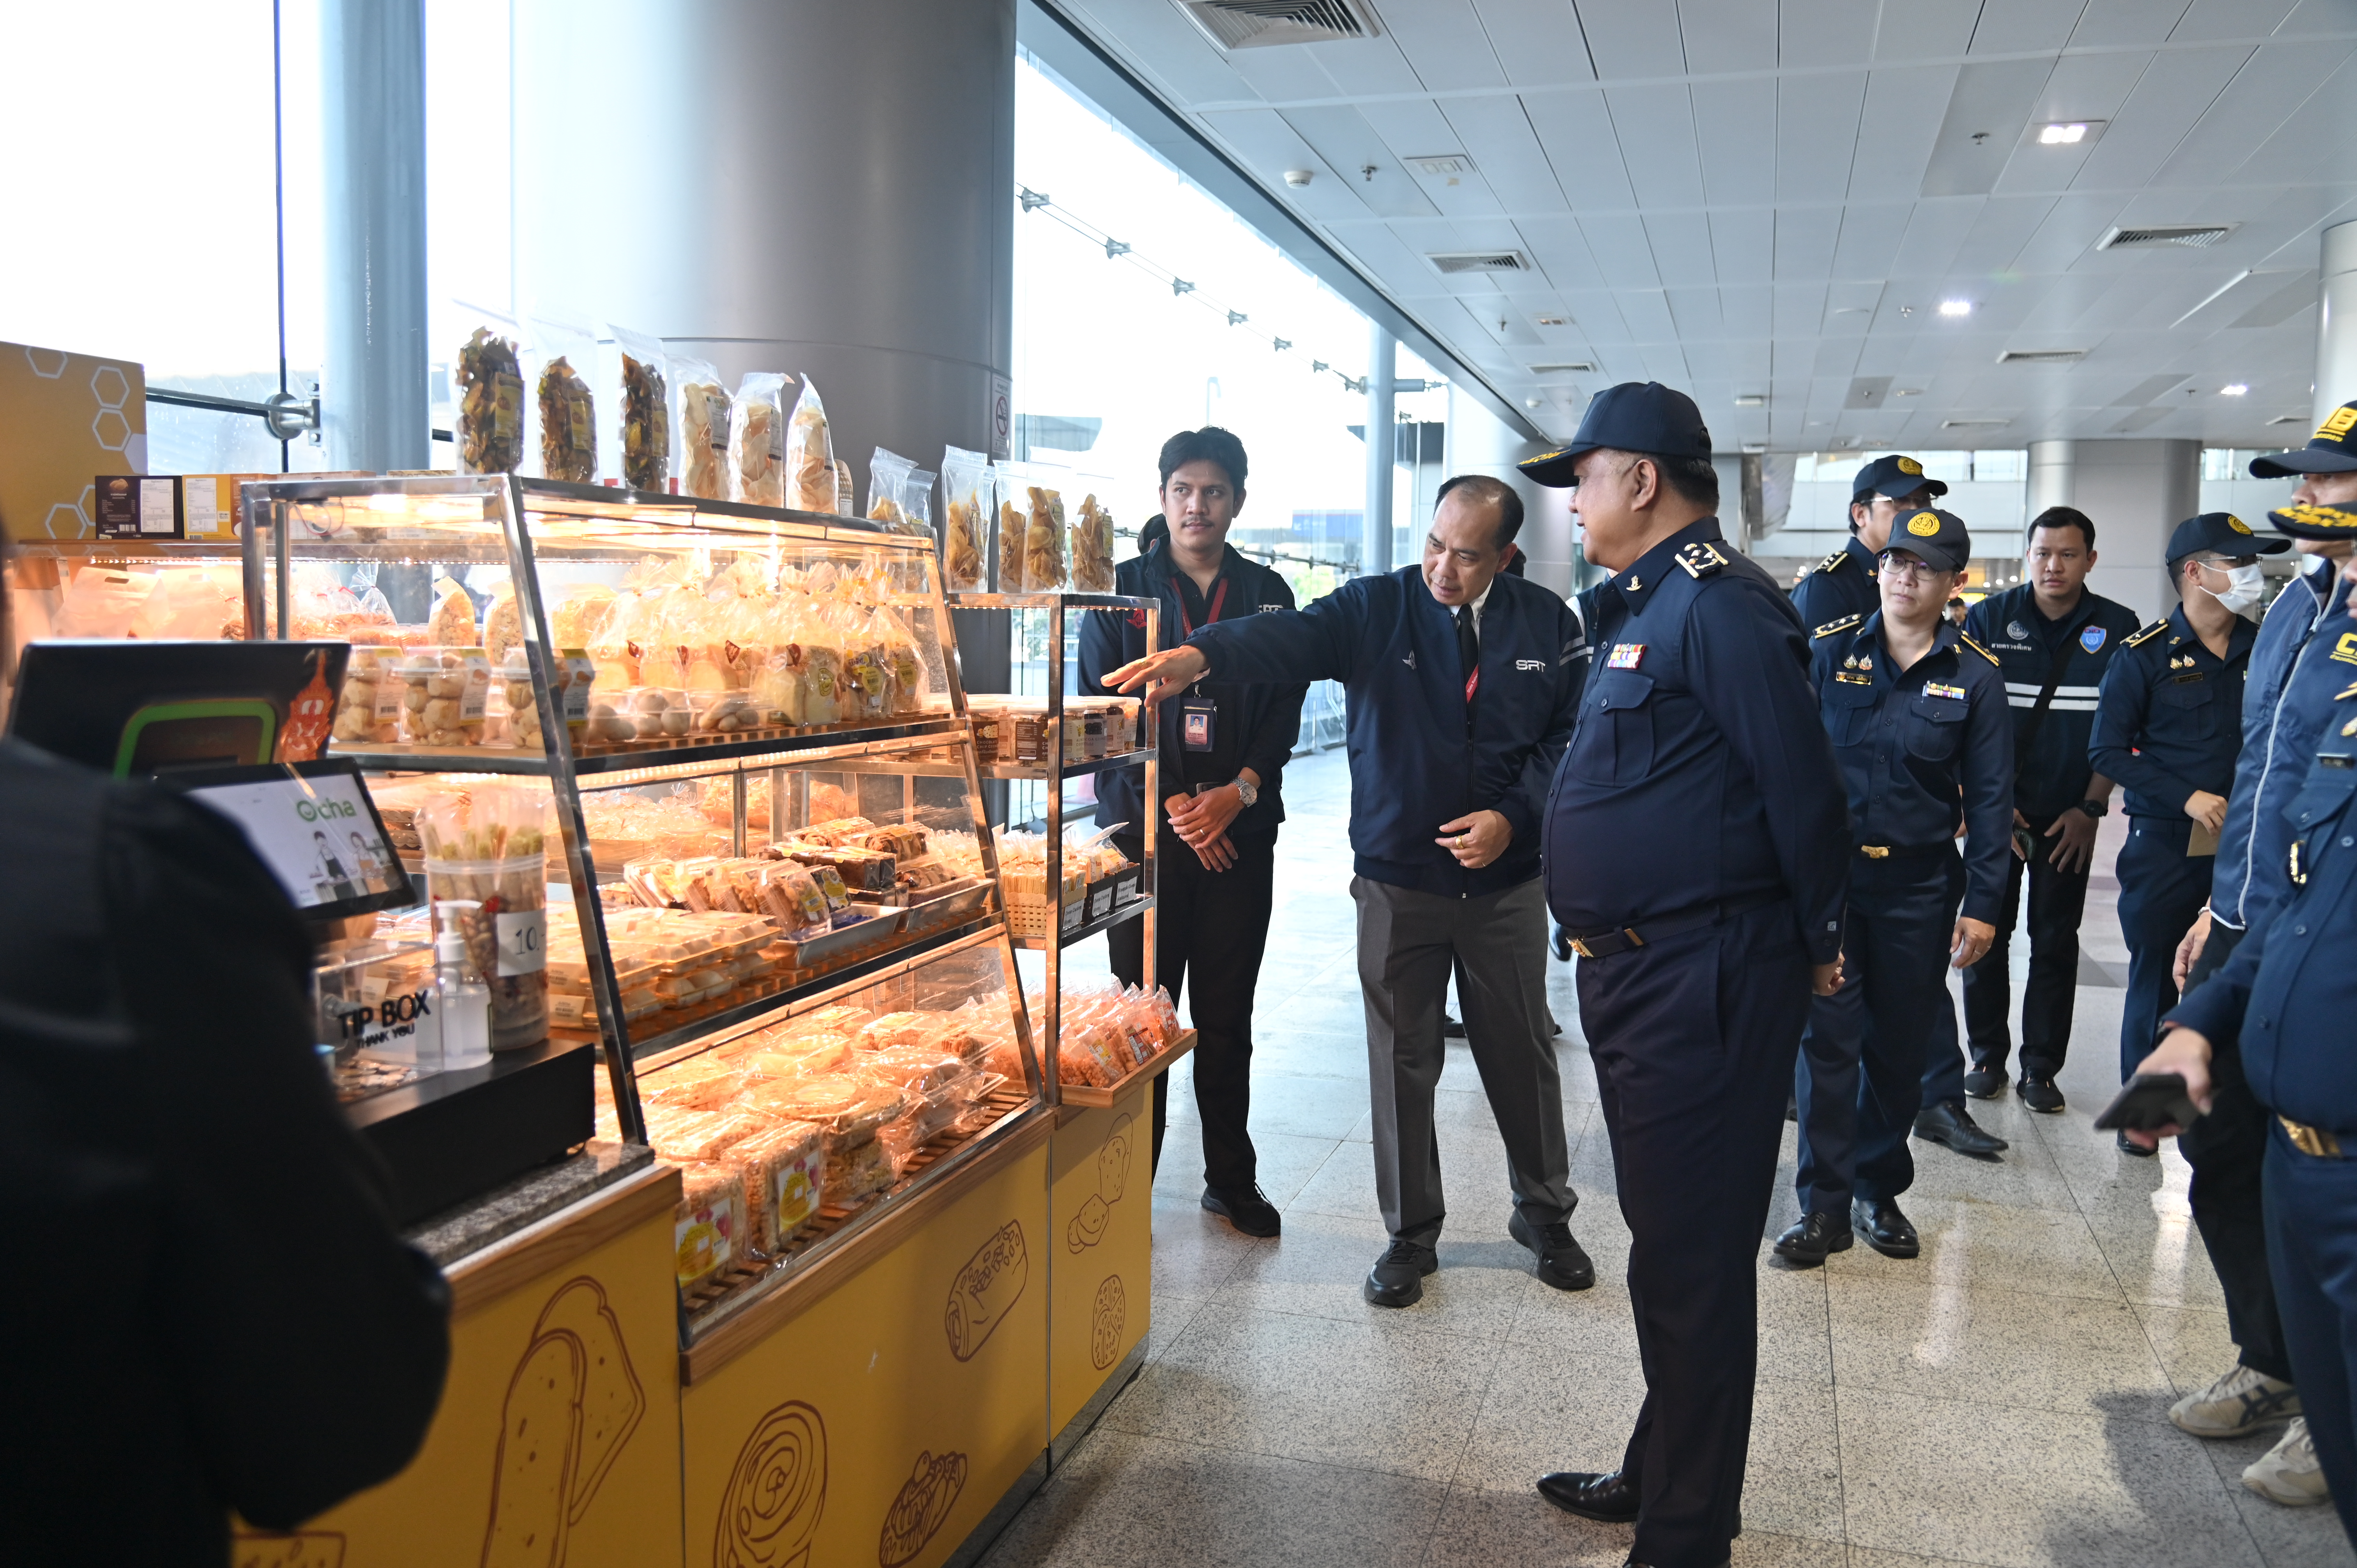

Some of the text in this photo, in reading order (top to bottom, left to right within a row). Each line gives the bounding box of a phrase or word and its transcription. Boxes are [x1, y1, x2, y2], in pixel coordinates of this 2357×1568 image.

[2320, 407, 2357, 432] IB
[1991, 642, 2032, 652] สายตรวจพิเศษ
[2336, 632, 2357, 655] C
[1516, 659, 1546, 673] SRT
[296, 797, 357, 822] Ocha
[338, 989, 431, 1038] TIP BOX
[357, 1022, 415, 1049] THANK YOU
